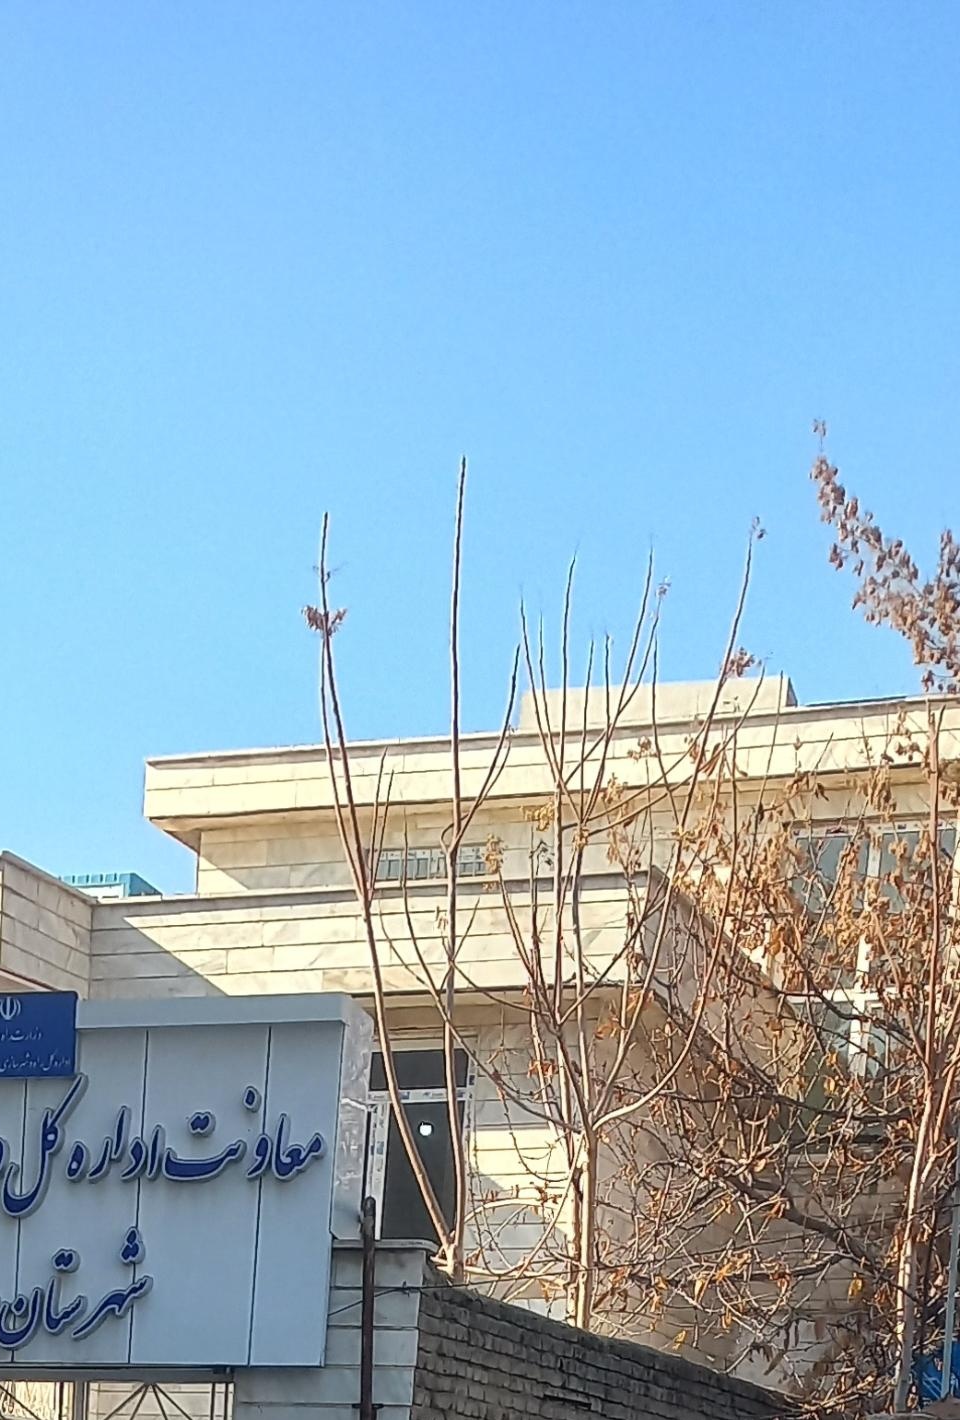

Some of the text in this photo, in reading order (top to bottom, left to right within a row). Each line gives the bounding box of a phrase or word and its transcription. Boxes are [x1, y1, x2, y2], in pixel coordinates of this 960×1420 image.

[1, 1072, 88, 1218] کل
[66, 1105, 164, 1184] اداره
[163, 1085, 326, 1181] معاونت
